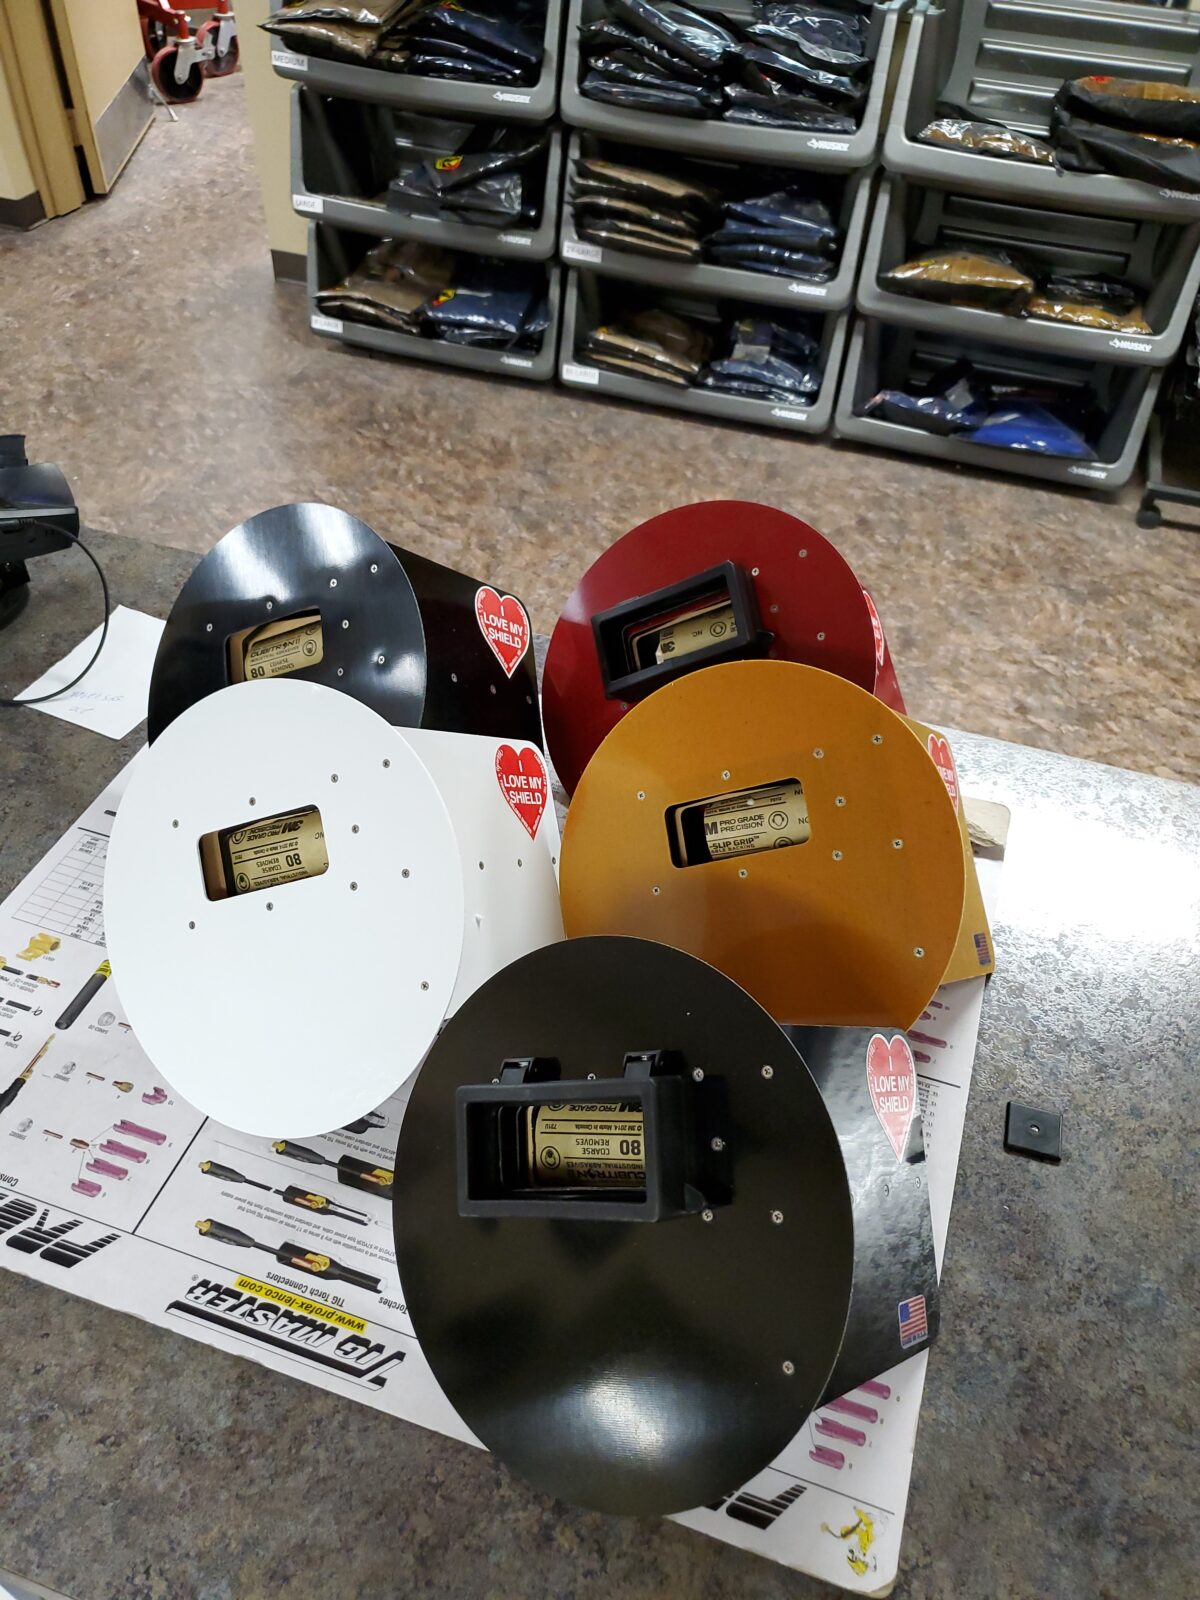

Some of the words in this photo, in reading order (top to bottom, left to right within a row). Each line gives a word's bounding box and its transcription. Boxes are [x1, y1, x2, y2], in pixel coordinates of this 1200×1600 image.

[484, 612, 508, 630] LOVE
[510, 622, 523, 636] MY
[488, 628, 521, 648] SHIELD
[270, 658, 288, 668] COARSE
[271, 663, 294, 673] REMOVES
[250, 666, 265, 679] 80
[519, 760, 523, 772] I
[503, 774, 528, 788] LOVE
[529, 777, 542, 789] MY
[510, 791, 542, 804] SHIELD
[738, 814, 764, 824] GRADE
[282, 820, 303, 834] 3M
[720, 822, 764, 833] PRECISION
[247, 832, 266, 842] GRADE
[256, 857, 279, 868] REMOVES
[285, 853, 302, 867] 80
[262, 864, 282, 874] COARSE
[875, 1076, 896, 1093] LOVE
[898, 1076, 910, 1091] MY
[880, 1096, 909, 1113] SHIELD
[620, 1140, 641, 1155] 80
[266, 1272, 307, 1294] Connectors
[309, 1289, 329, 1304] Torch
[330, 1297, 345, 1308] TIG
[238, 1278, 366, 1332] www.profax-lenco.com
[378, 1296, 408, 1315] Torches
